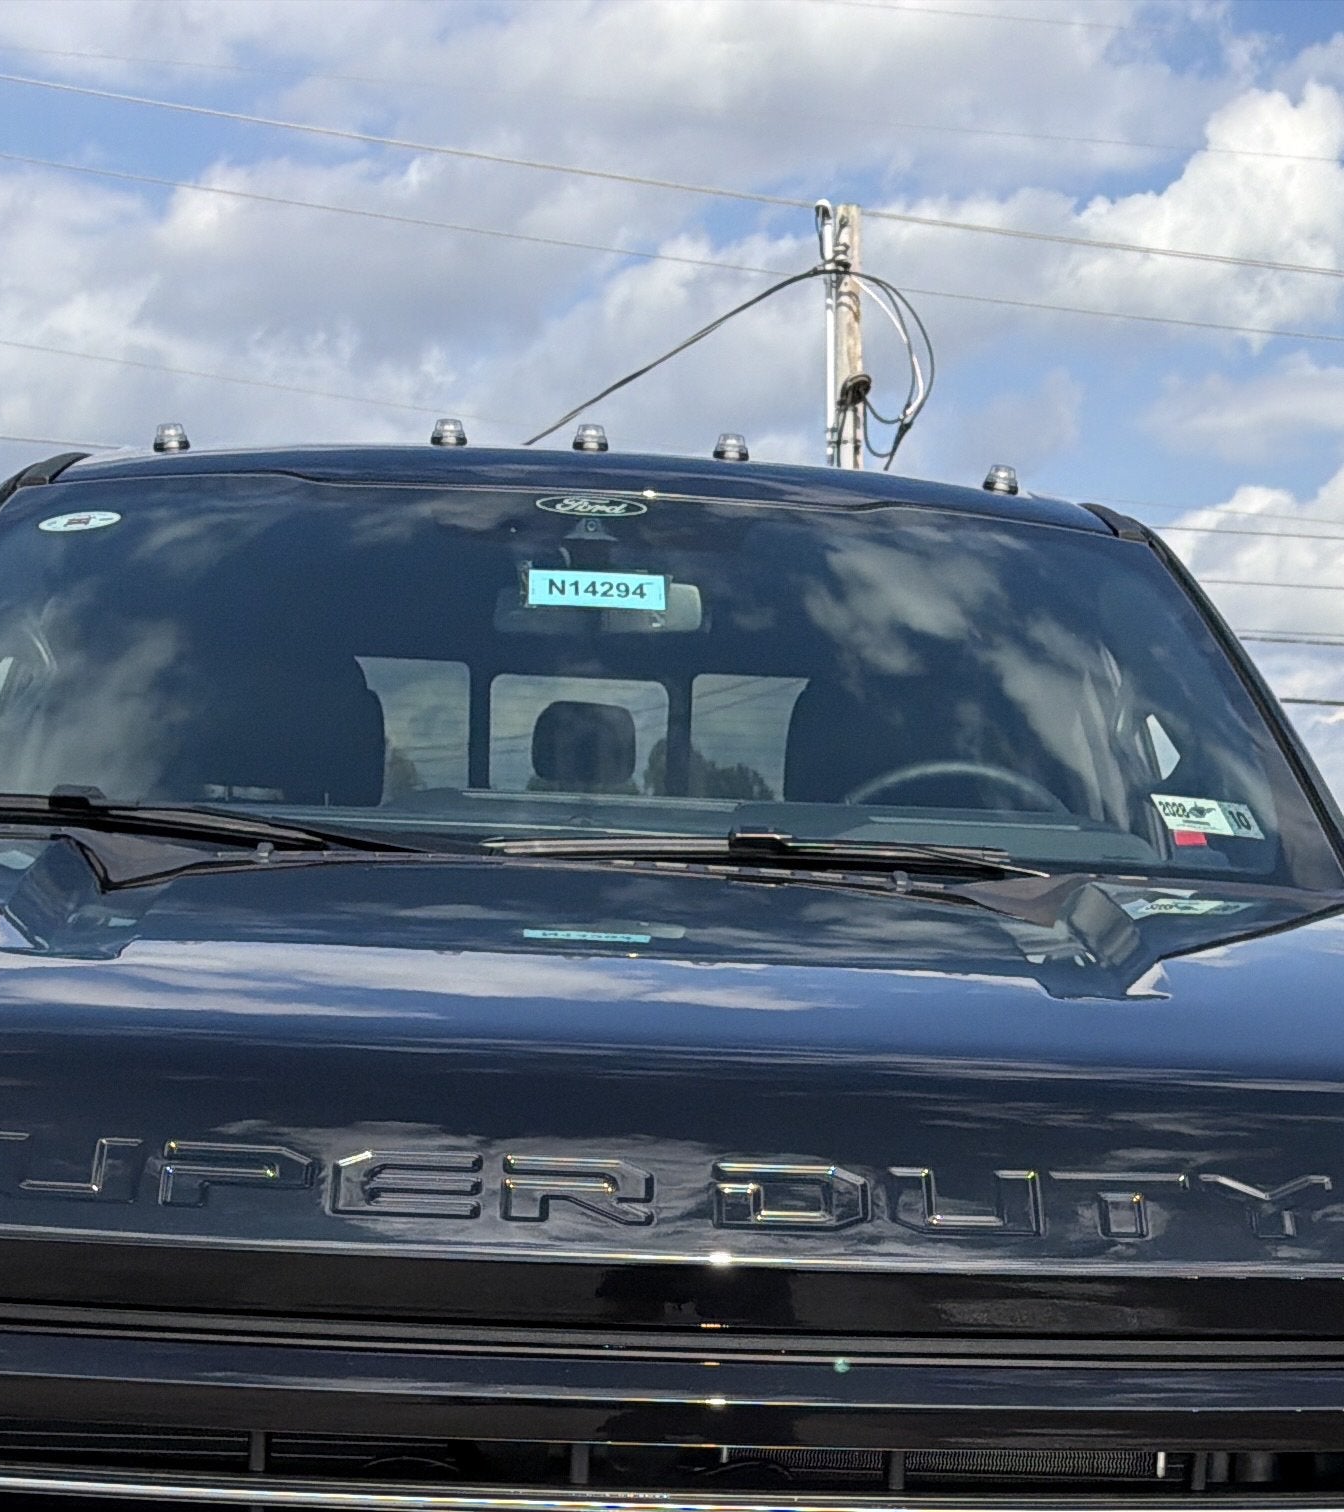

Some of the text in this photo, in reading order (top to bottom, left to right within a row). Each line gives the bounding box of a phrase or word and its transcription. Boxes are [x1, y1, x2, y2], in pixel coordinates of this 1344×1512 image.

[556, 496, 628, 513] Ford
[547, 577, 648, 600] N14294
[1227, 810, 1252, 831] 10
[711, 1158, 1332, 1240] DUTY
